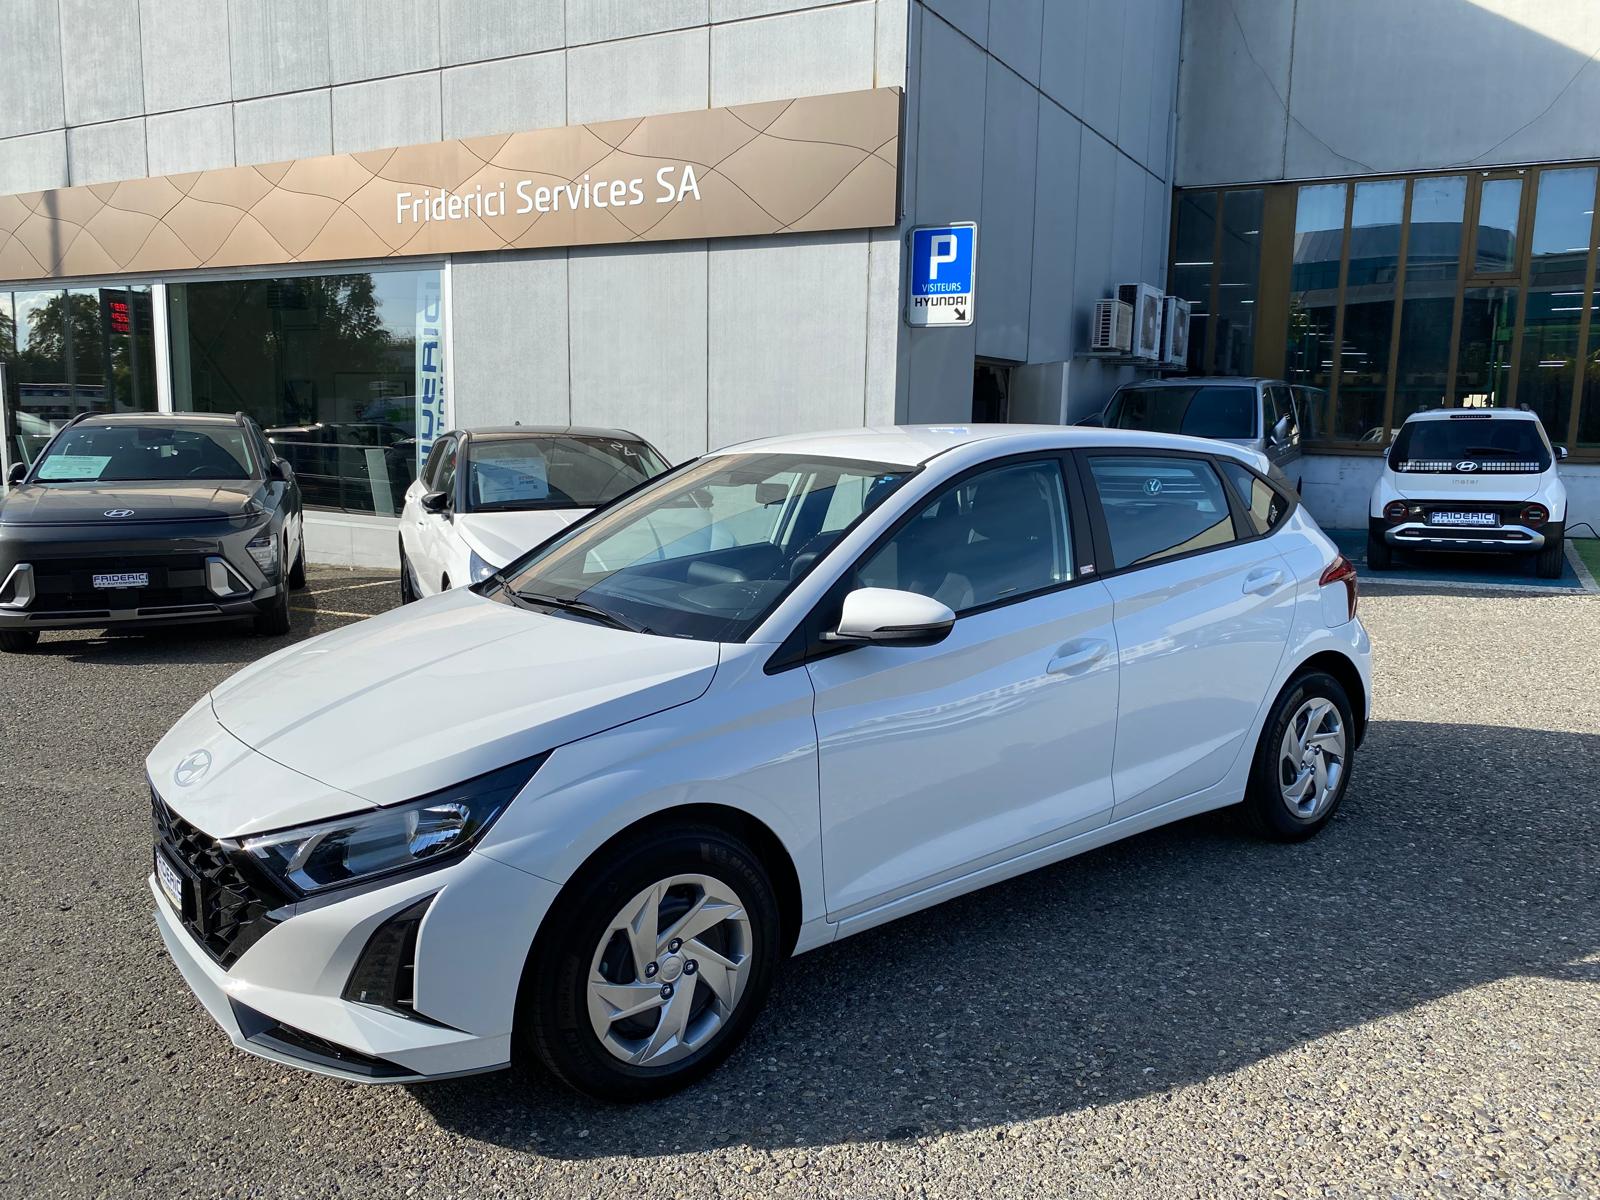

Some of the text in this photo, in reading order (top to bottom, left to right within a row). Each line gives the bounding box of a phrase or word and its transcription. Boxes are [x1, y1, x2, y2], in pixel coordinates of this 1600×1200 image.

[396, 165, 701, 224] Friderici Services SA
[929, 234, 958, 280] P
[921, 282, 962, 293] VISITEURS
[914, 295, 967, 307] HYUNDAI
[1432, 512, 1495, 520] FRIDERICI
[94, 574, 147, 582] FRIDERICI
